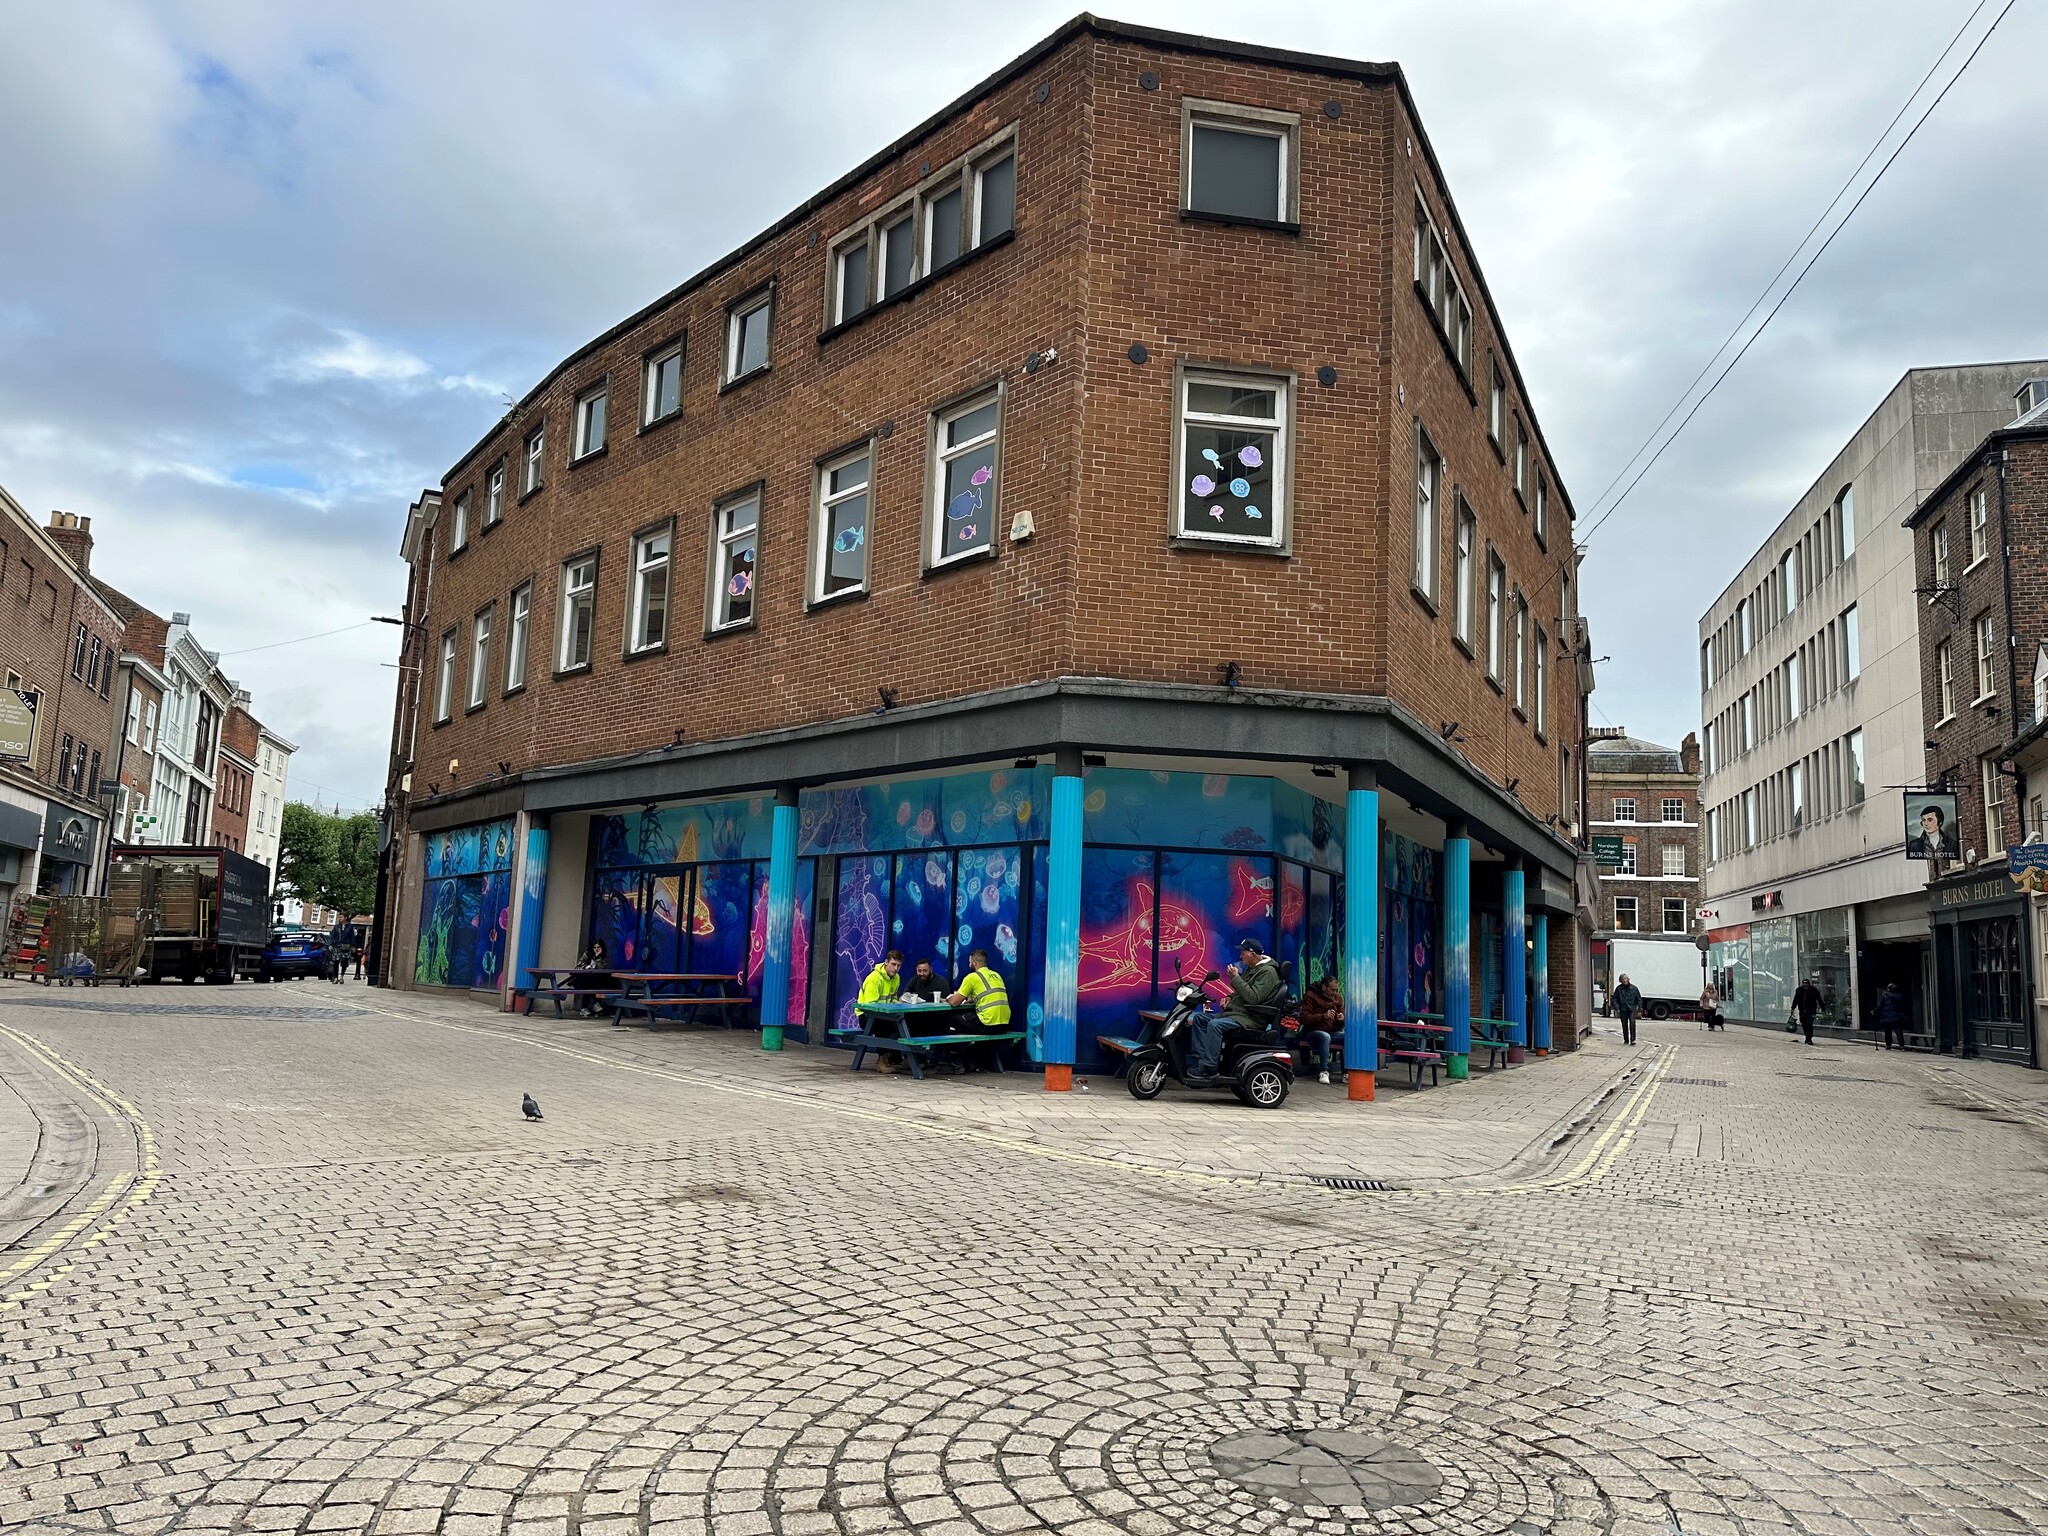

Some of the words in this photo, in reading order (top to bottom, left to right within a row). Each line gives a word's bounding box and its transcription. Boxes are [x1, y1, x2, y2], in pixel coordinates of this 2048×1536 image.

[17, 690, 26, 700] TO
[24, 698, 36, 710] LET
[2013, 859, 2033, 867] Health
[1942, 886, 1969, 906] BURNS
[1974, 879, 2006, 900] HOTEL
